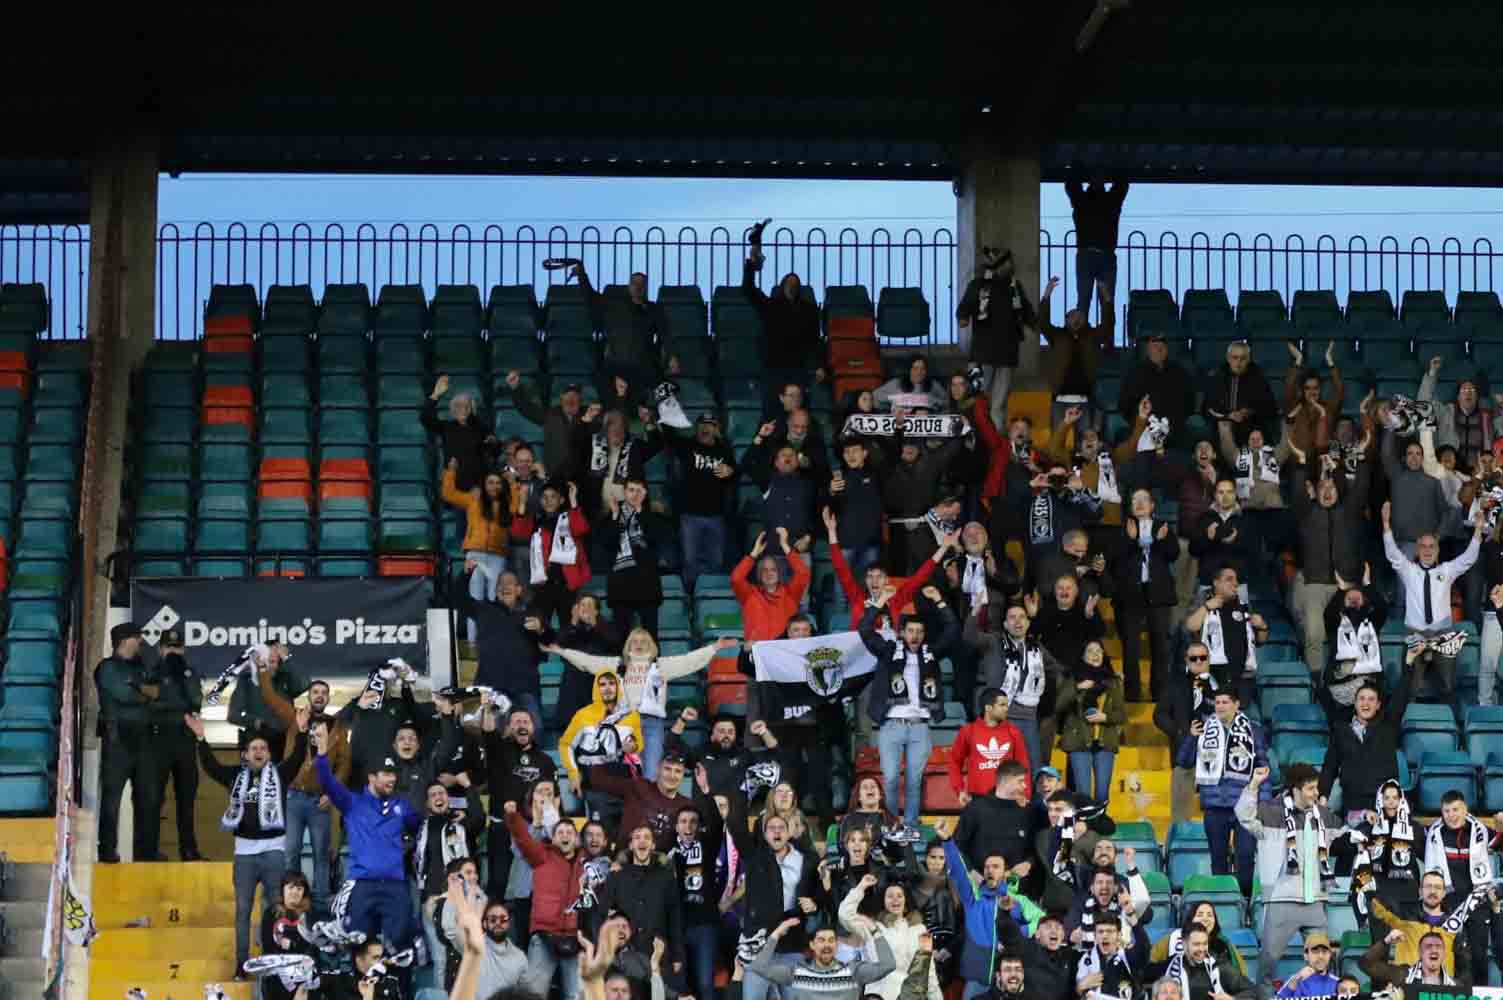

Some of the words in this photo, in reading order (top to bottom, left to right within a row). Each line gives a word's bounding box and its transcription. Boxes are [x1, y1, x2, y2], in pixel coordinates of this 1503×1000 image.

[184, 618, 327, 647] Domino's
[335, 617, 418, 645] Pizza
[979, 760, 1000, 770] adid
[168, 908, 180, 922] 8
[169, 964, 180, 979] 7
